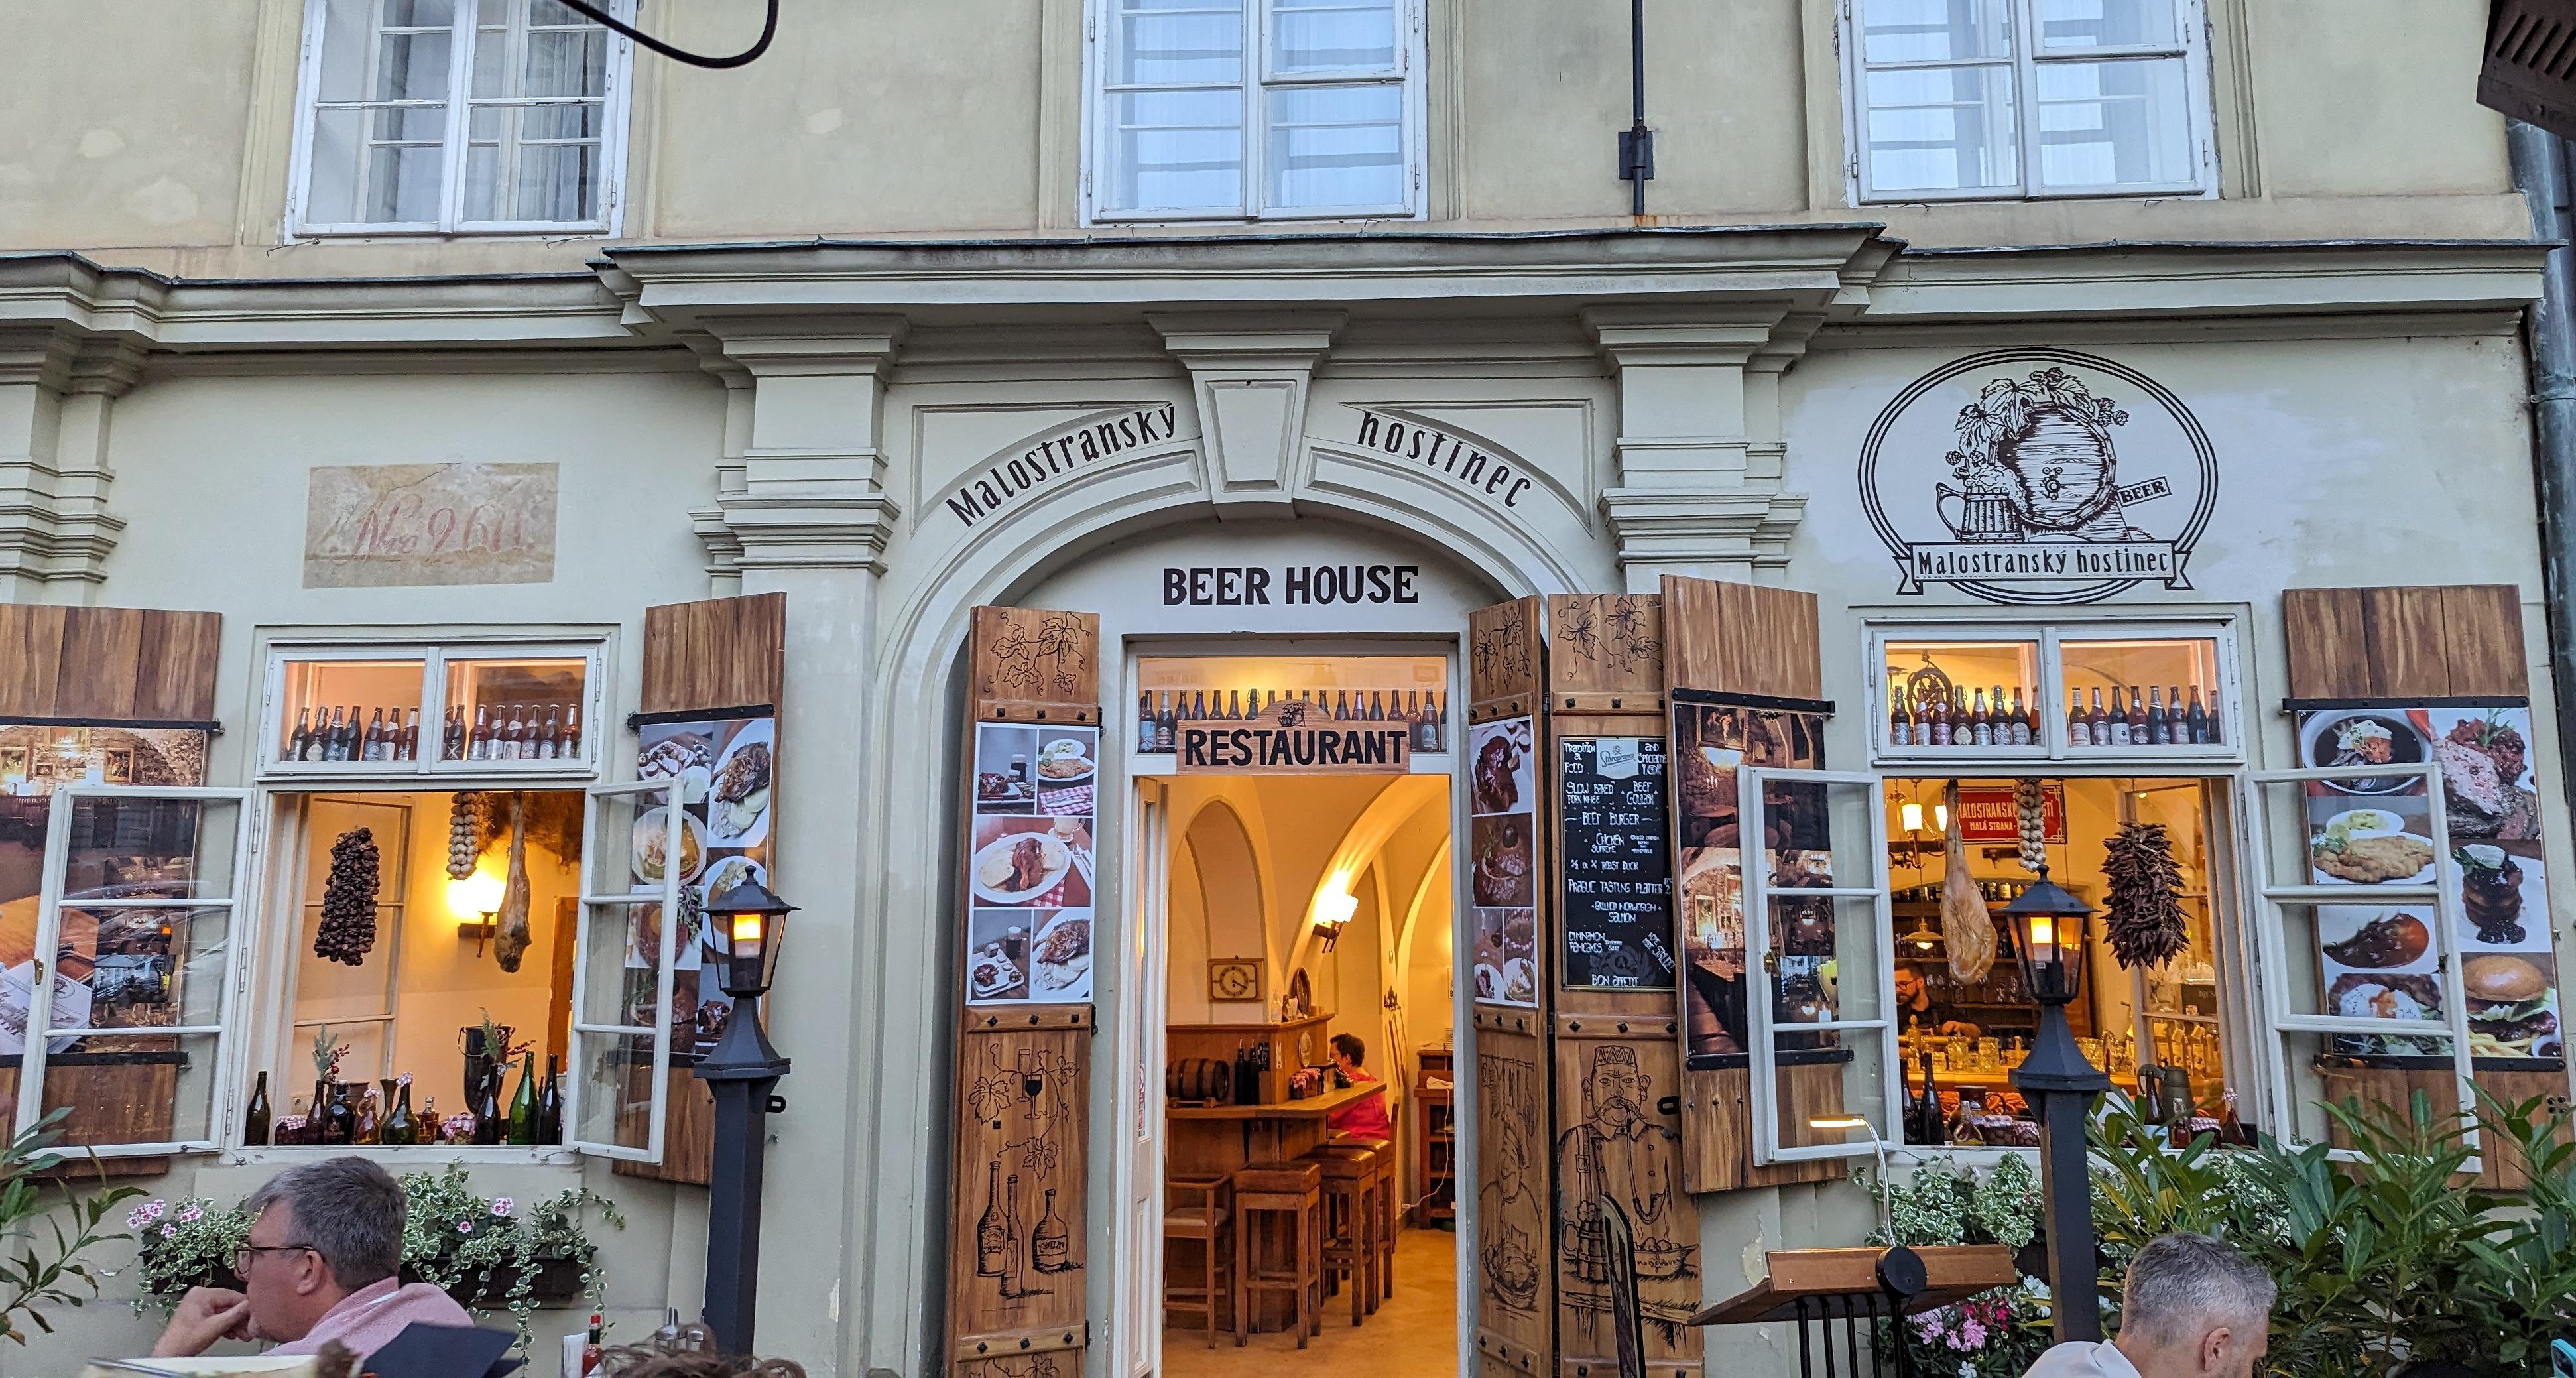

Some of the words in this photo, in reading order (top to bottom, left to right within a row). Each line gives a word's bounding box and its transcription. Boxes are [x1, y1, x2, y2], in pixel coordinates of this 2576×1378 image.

[946, 403, 1176, 528] Malostranský
[1357, 411, 1532, 507] hostinec
[2122, 481, 2168, 503] BEER
[1918, 544, 2068, 576] Malostranský
[2076, 547, 2170, 574] hostinec
[1162, 566, 1270, 605] BEER
[1286, 565, 1419, 605] HOUSE
[1185, 729, 1408, 766] RESTAURANT
[1565, 781, 1589, 794] SLOW
[1632, 781, 1652, 792] BEEF
[1583, 795, 1600, 804] KNEE
[1582, 811, 1601, 826] BEEF
[1609, 812, 1640, 826] BURGER
[1595, 832, 1625, 846] CHICKEN
[1622, 861, 1639, 871] DUCK
[1599, 881, 1630, 893] TASTING
[1591, 974, 1610, 987] BON
